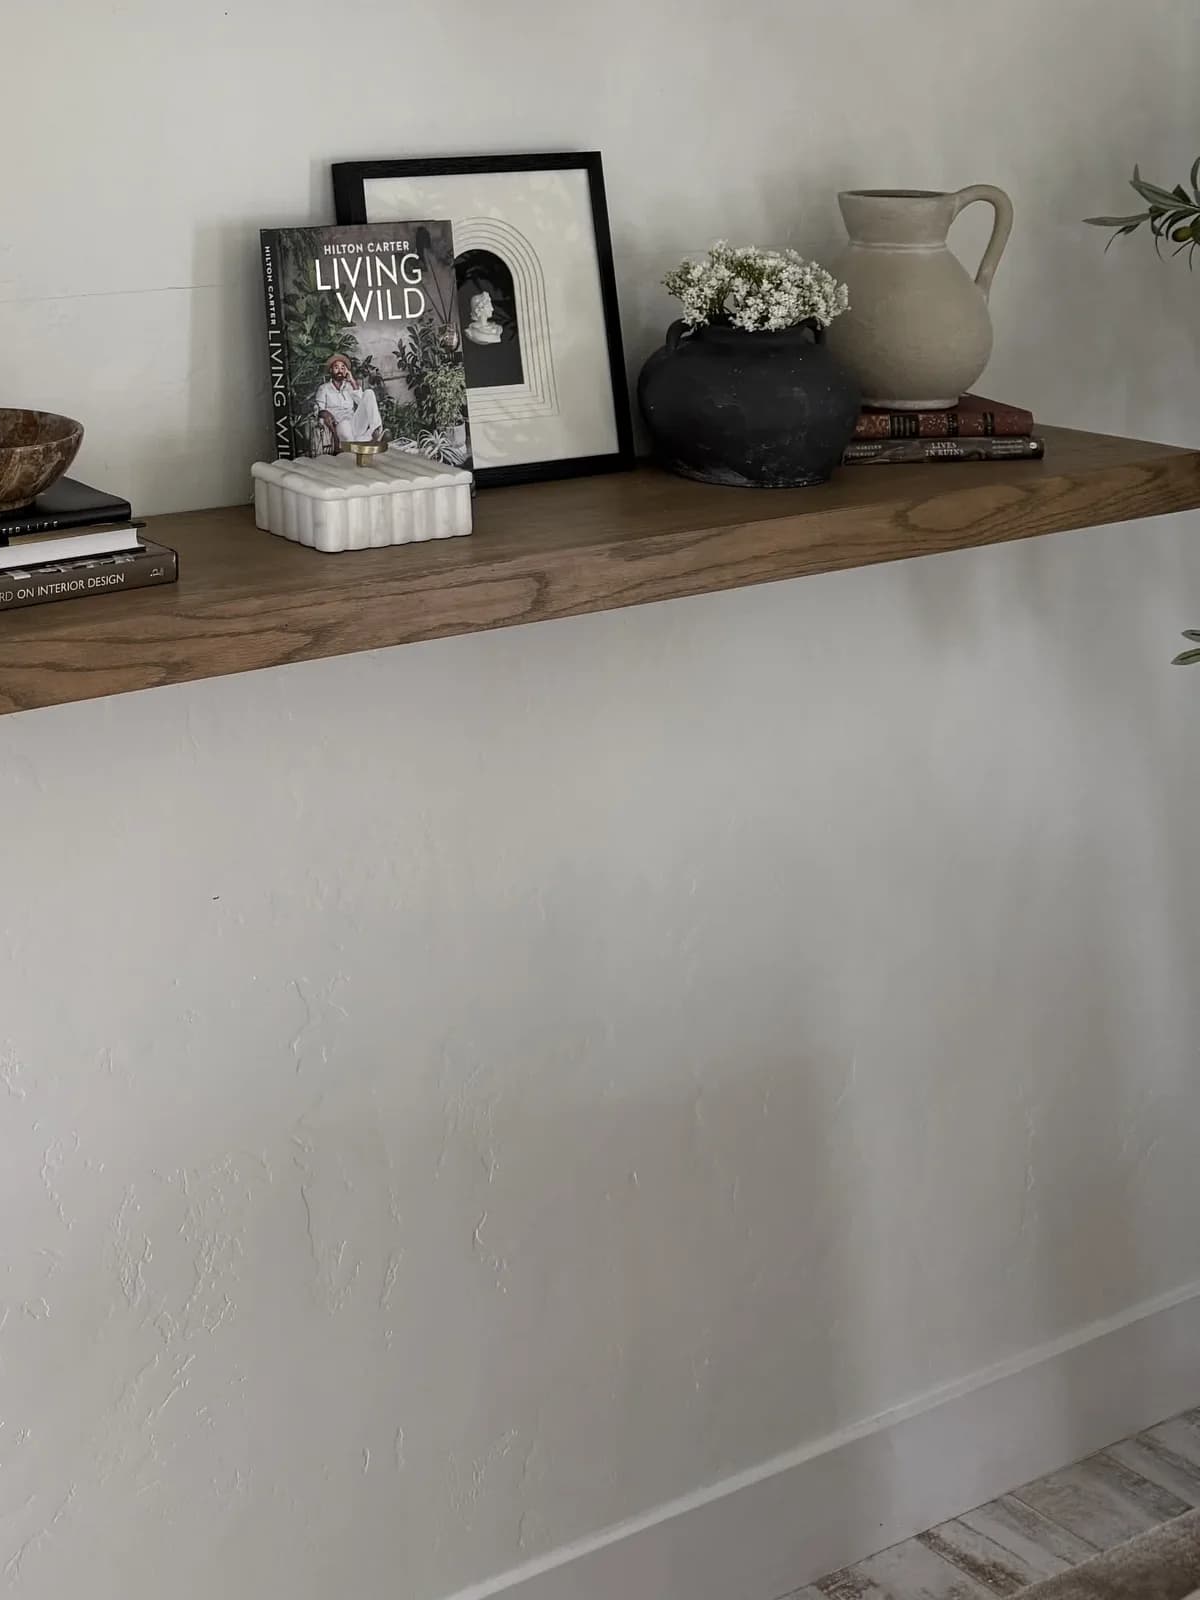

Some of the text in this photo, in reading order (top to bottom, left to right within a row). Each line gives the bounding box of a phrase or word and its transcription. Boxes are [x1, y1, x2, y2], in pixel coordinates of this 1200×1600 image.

[323, 241, 410, 255] HILTON CARTER
[315, 253, 422, 291] LIVING
[336, 287, 425, 323] WILD
[264, 245, 291, 460] HILTON CARTER LIVING WIL
[931, 441, 958, 449] LIVES
[937, 448, 965, 456] RUINS
[17, 586, 35, 600] ON
[37, 579, 86, 597] INTERIOR
[88, 572, 125, 589] DESIGN
